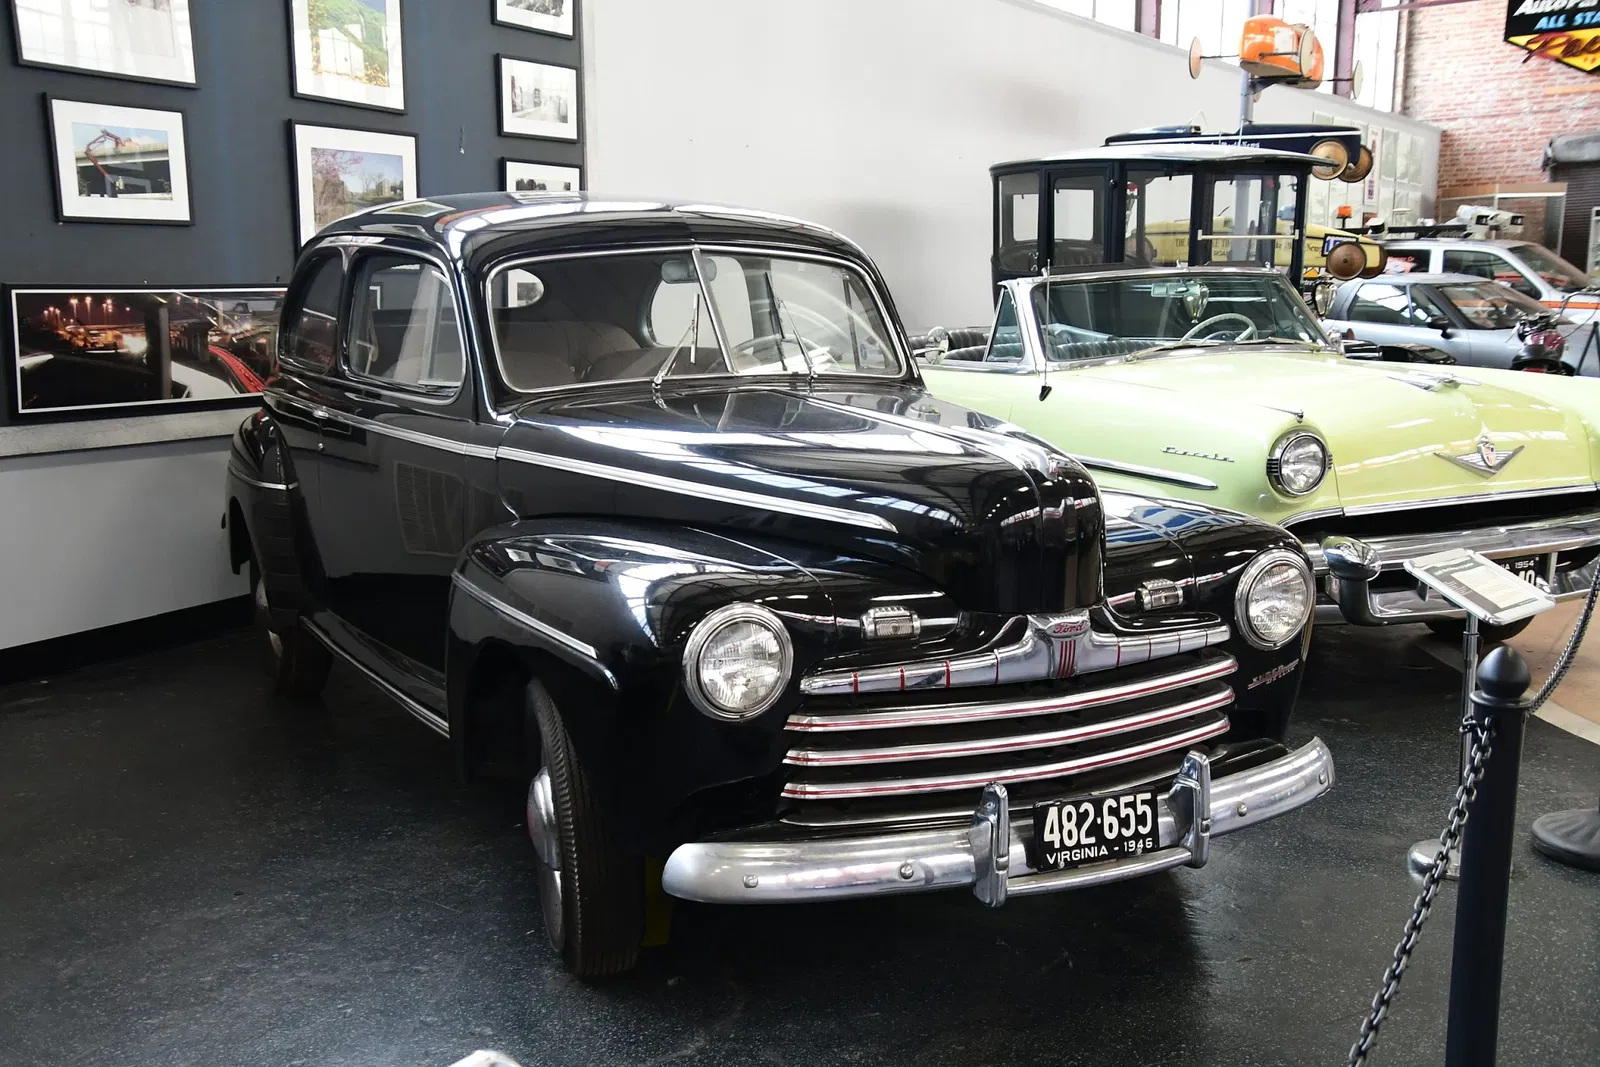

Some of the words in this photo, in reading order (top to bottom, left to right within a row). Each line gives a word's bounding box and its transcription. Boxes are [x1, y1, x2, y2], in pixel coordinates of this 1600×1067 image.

[1533, 14, 1566, 31] ALL
[1515, 560, 1535, 569] 1954
[1053, 620, 1088, 634] Ford
[1046, 845, 1109, 865] VIRGINIA
[1123, 837, 1154, 853] 1946
